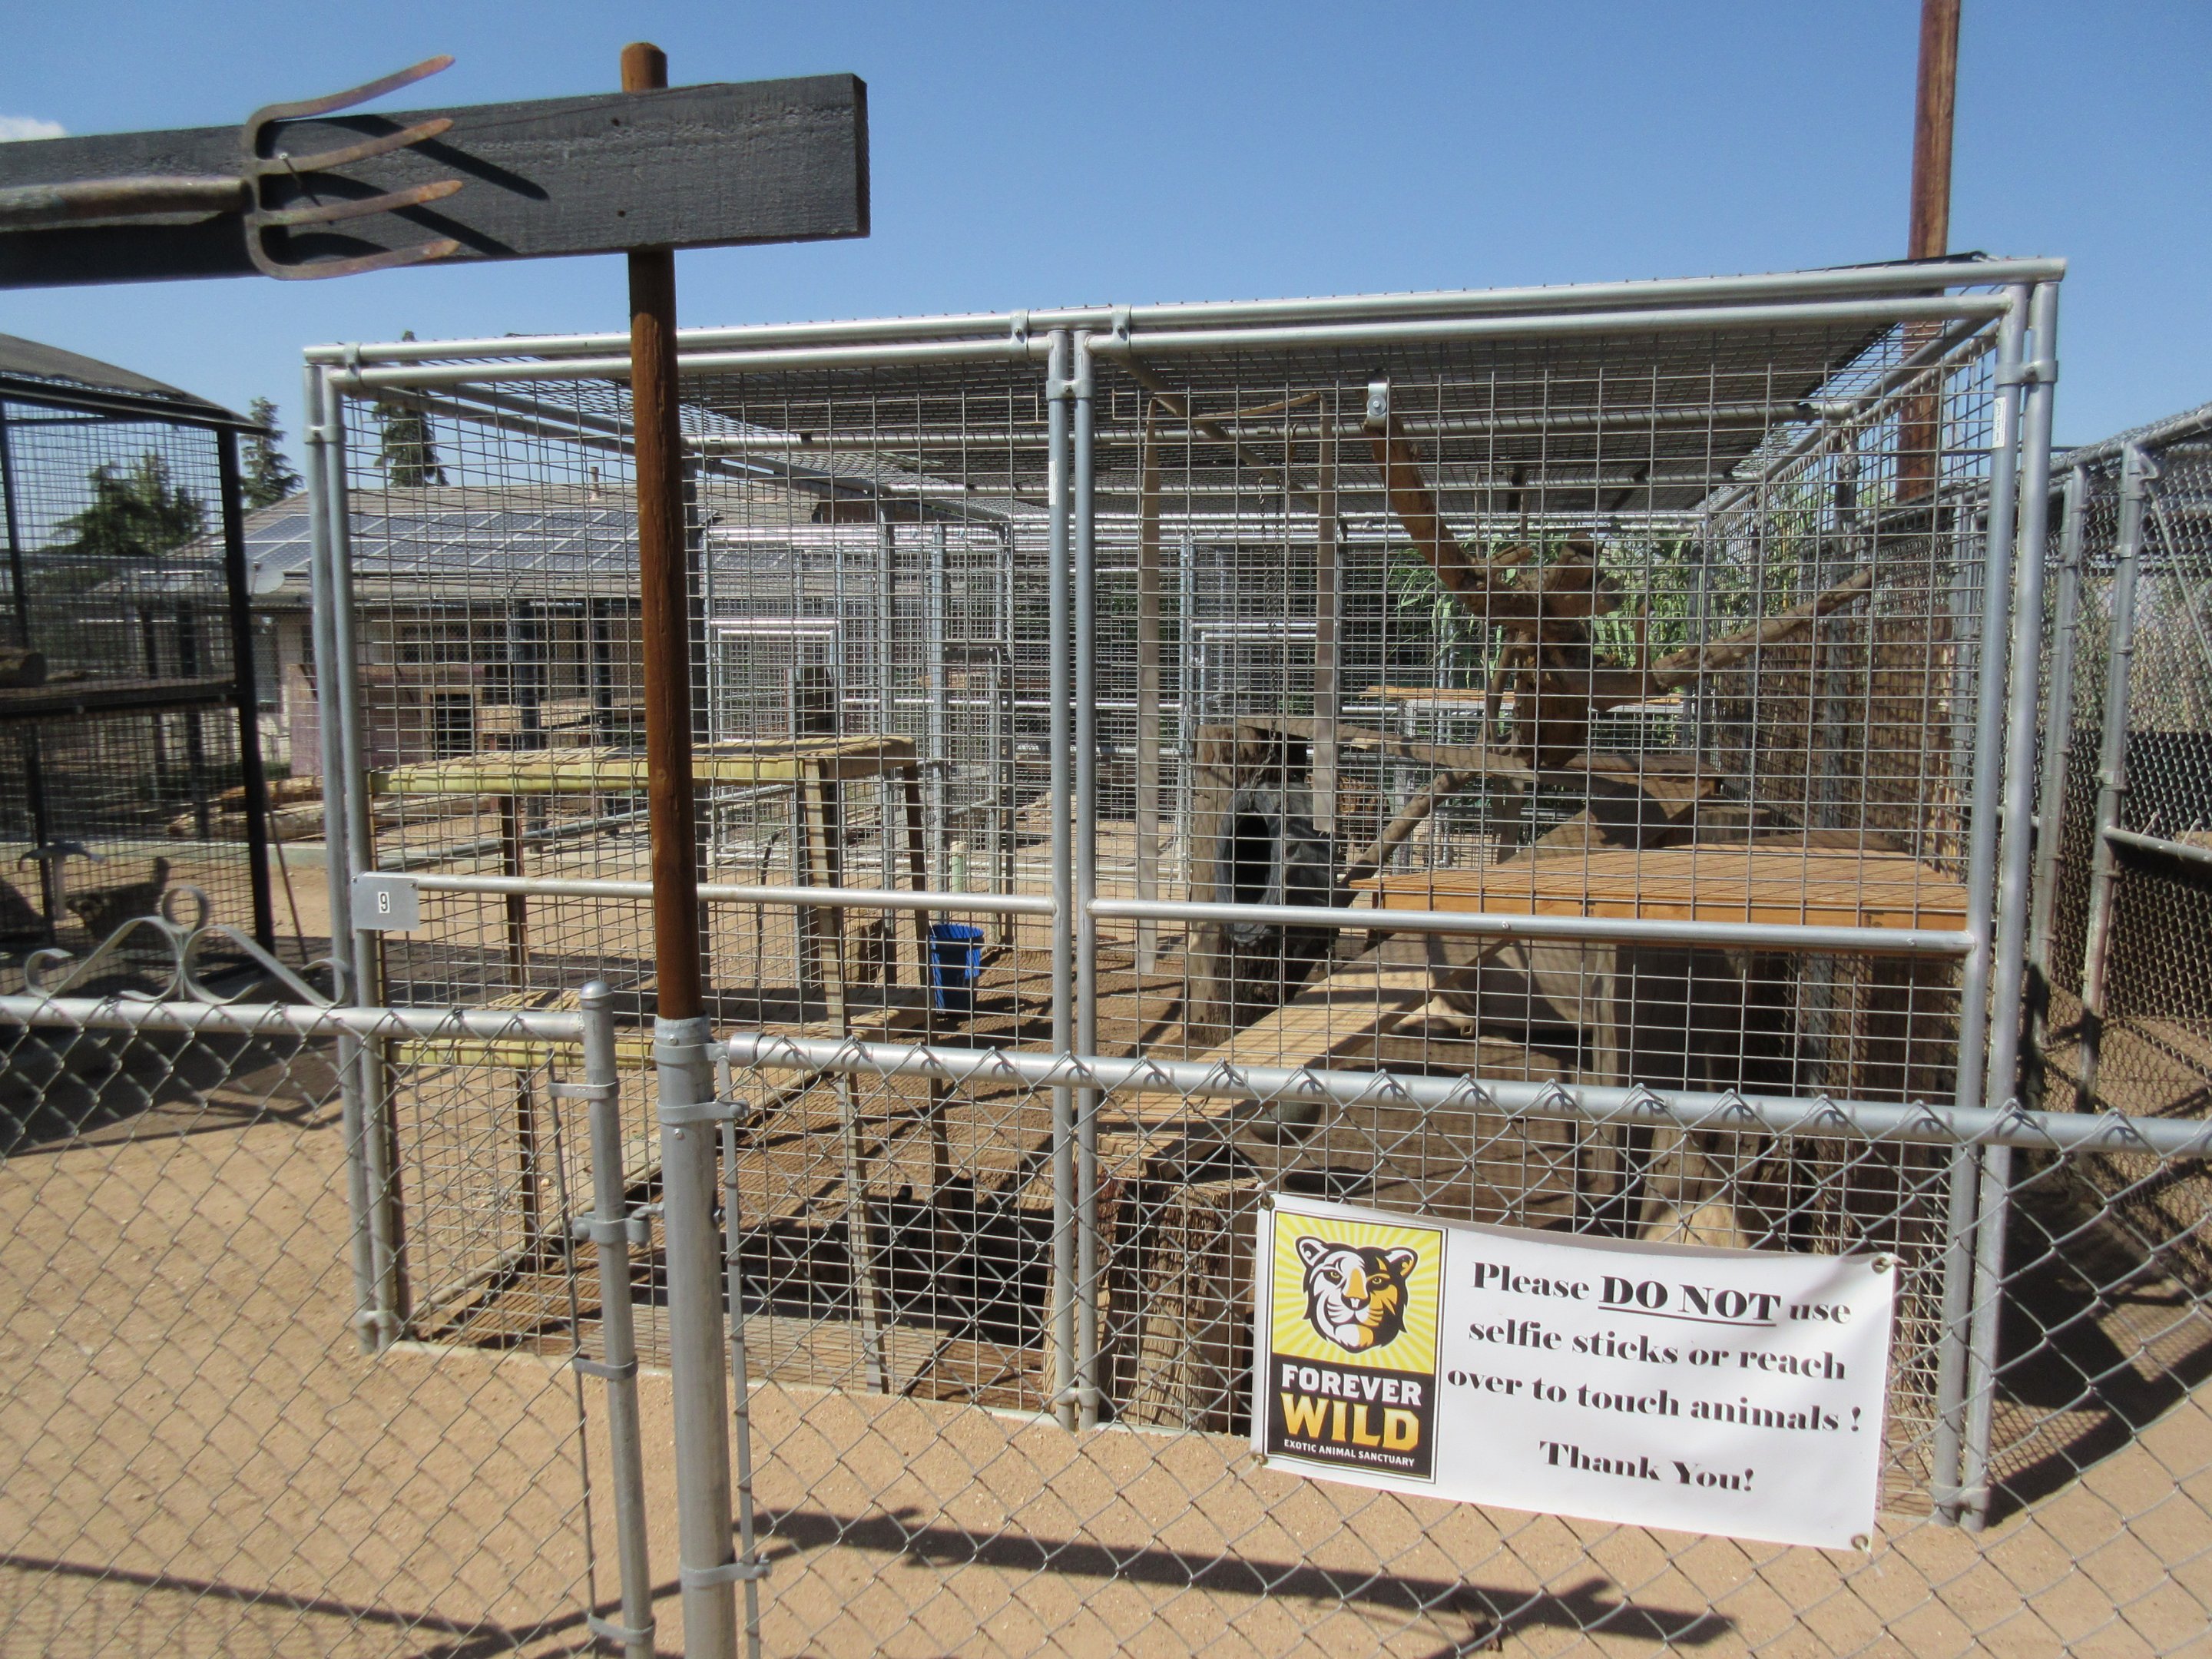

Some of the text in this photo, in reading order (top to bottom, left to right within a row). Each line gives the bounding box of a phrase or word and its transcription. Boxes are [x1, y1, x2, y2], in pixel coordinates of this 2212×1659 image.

[380, 893, 388, 912] 9
[1472, 1261, 1851, 1324] Please DO NOT use
[1469, 1318, 1845, 1380] selfie sticks or reach
[1280, 1363, 1422, 1406] FOREVER
[1447, 1369, 1523, 1396] over
[1532, 1376, 1568, 1402] to
[1577, 1383, 1680, 1416] touch
[1280, 1392, 1419, 1451] WILD
[1283, 1439, 1415, 1467] EXOTIC ANIMAL SANCTUARY
[1539, 1440, 1755, 1492] Thank You!
